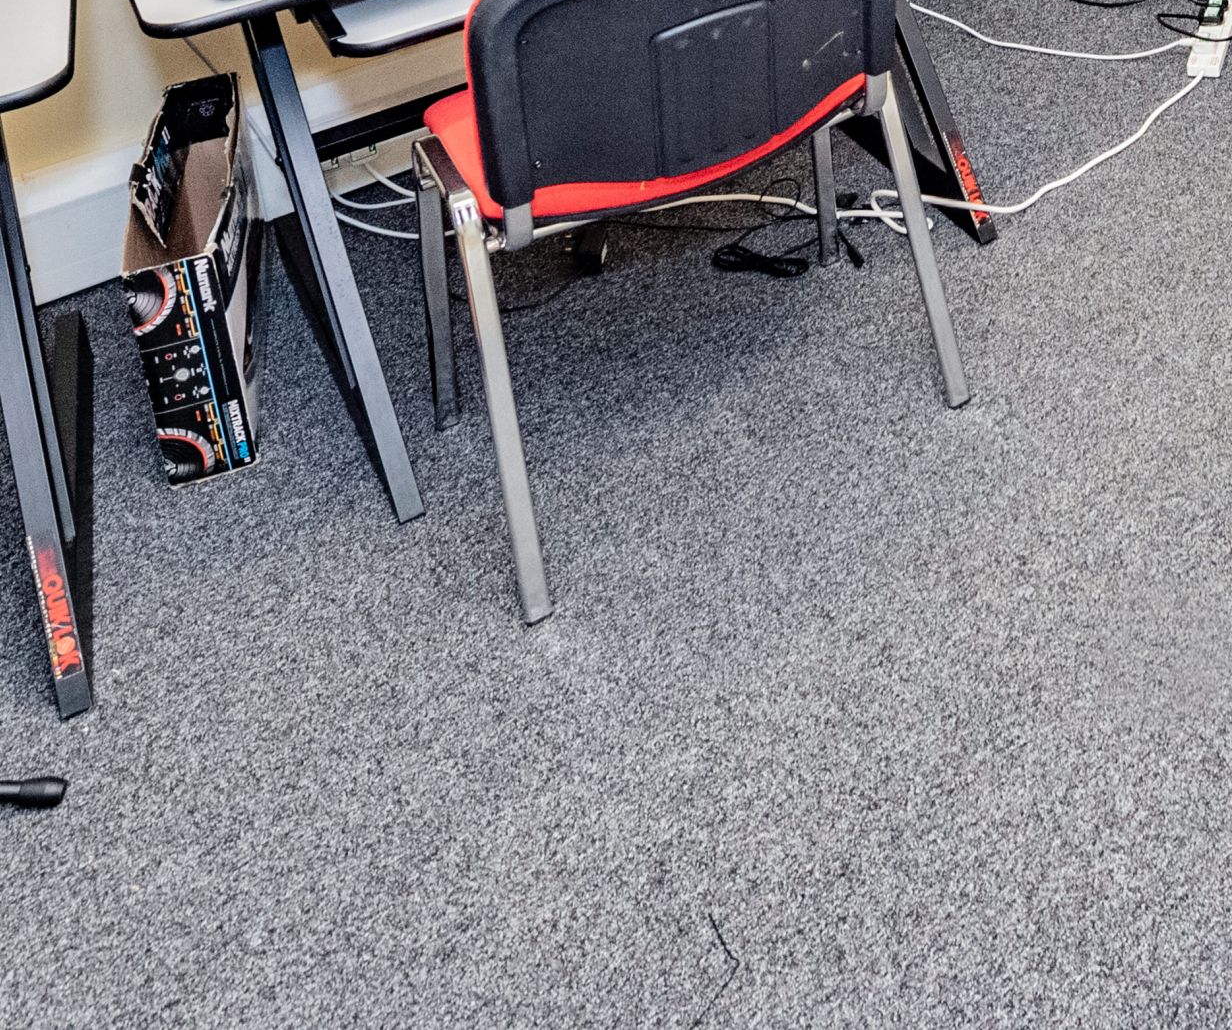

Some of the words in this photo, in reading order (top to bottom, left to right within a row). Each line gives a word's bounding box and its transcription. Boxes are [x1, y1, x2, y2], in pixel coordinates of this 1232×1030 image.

[193, 257, 218, 313] Numark
[227, 399, 247, 443] MIXTRACK
[236, 439, 251, 459] PRO
